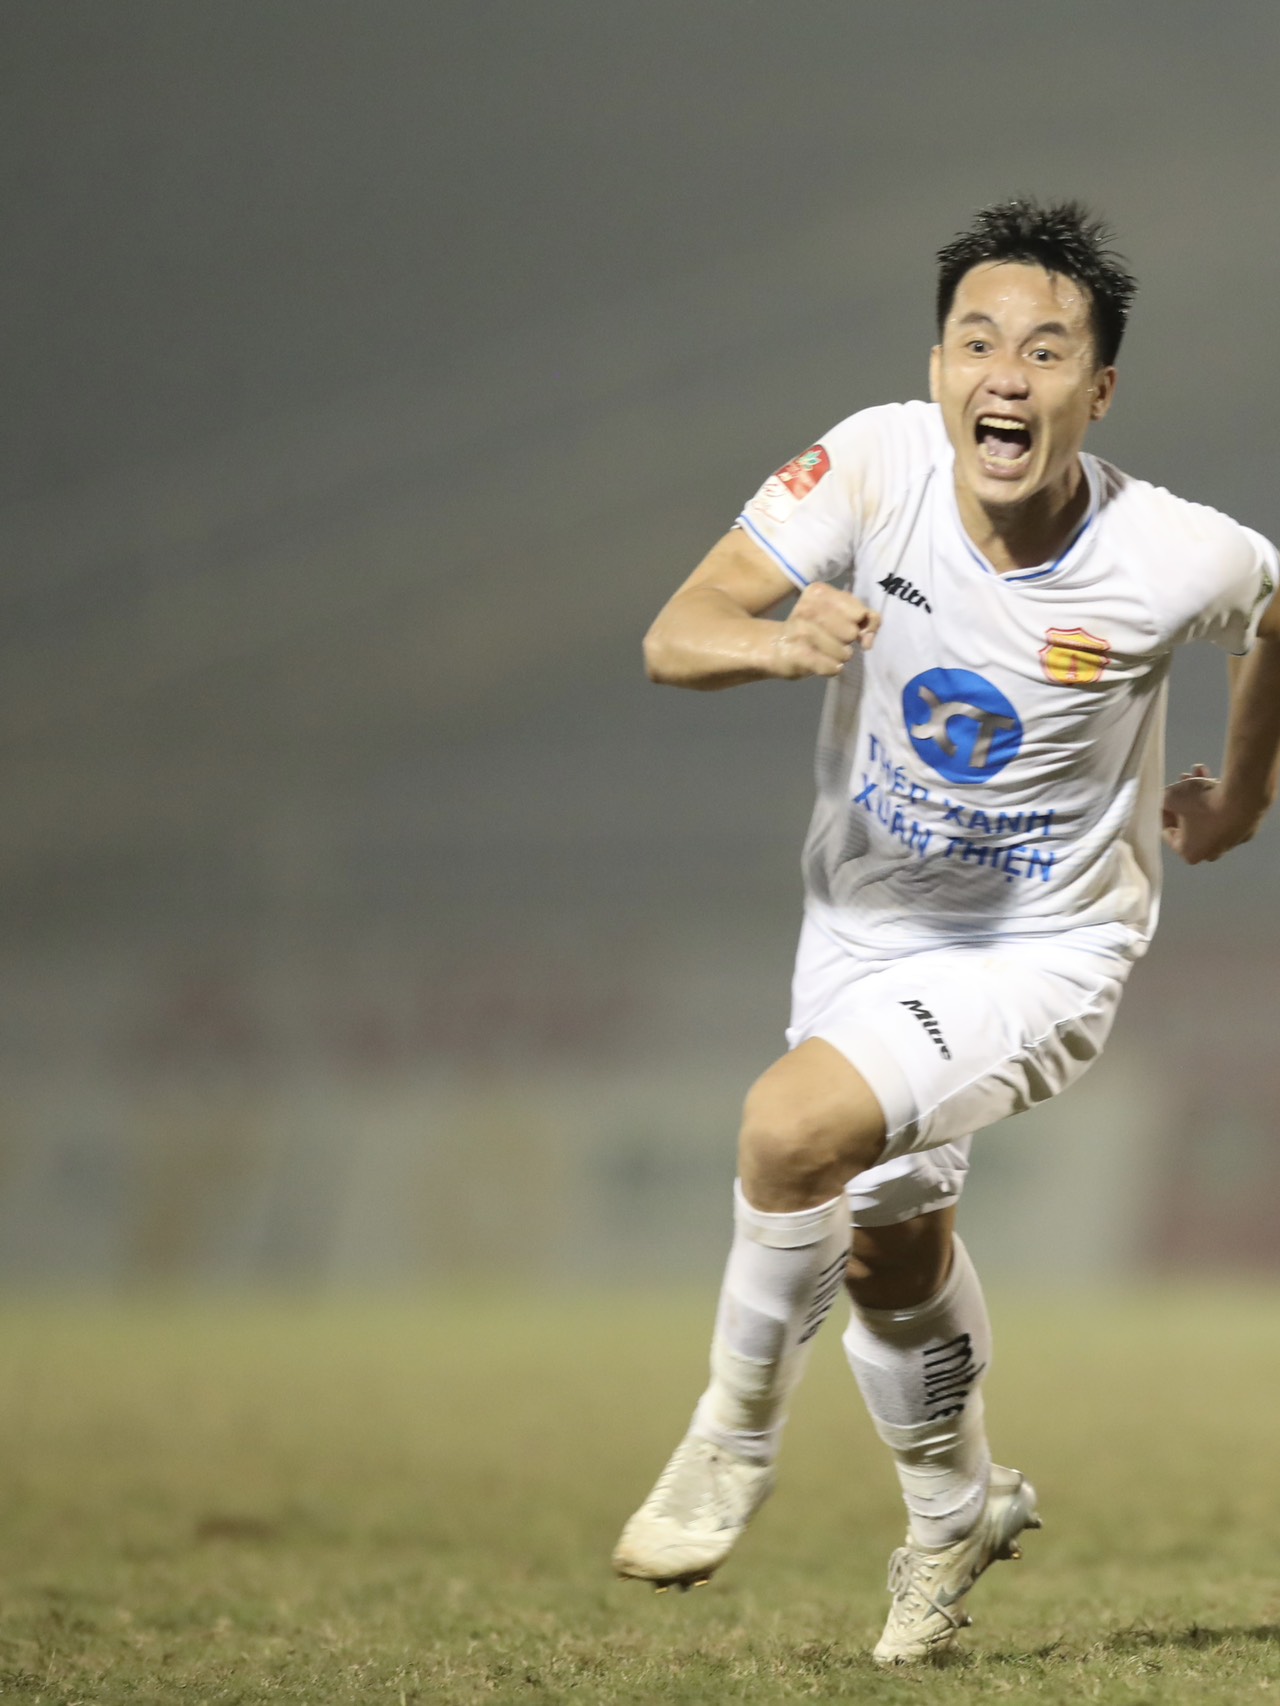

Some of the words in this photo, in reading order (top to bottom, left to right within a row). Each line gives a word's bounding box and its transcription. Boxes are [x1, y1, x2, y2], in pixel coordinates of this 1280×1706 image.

[876, 572, 932, 614] Mitr
[852, 771, 934, 858] XUÂN
[942, 798, 1056, 836] XANH
